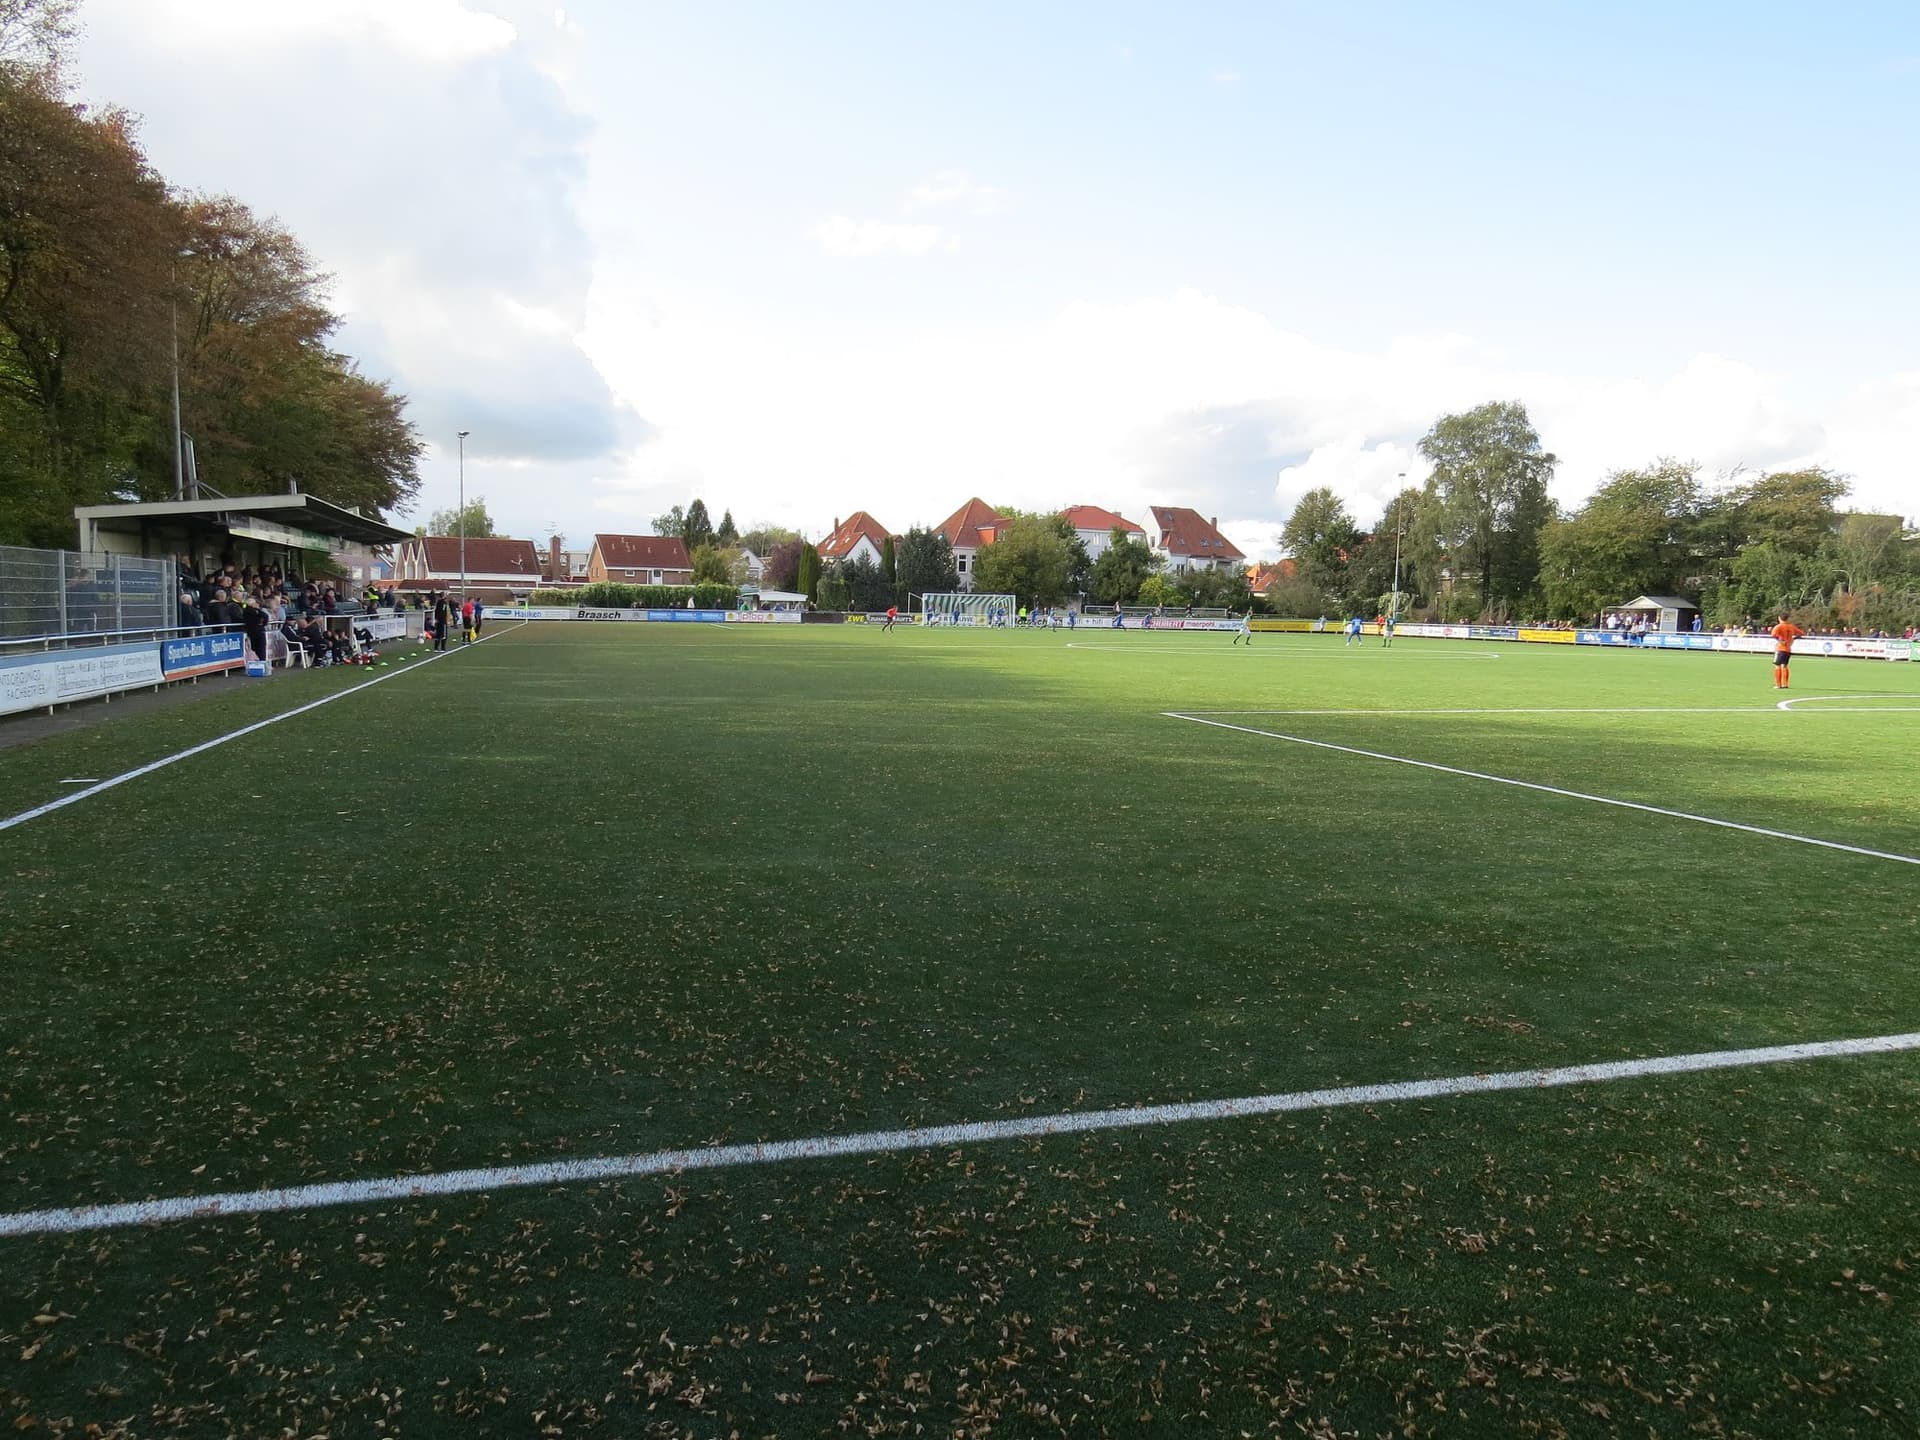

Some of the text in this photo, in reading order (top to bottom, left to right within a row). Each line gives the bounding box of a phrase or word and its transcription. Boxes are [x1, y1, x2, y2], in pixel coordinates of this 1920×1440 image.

[577, 610, 621, 619] Braasch
[168, 641, 206, 664] Sparda-Bank
[211, 637, 241, 657] Sparda-Bank
